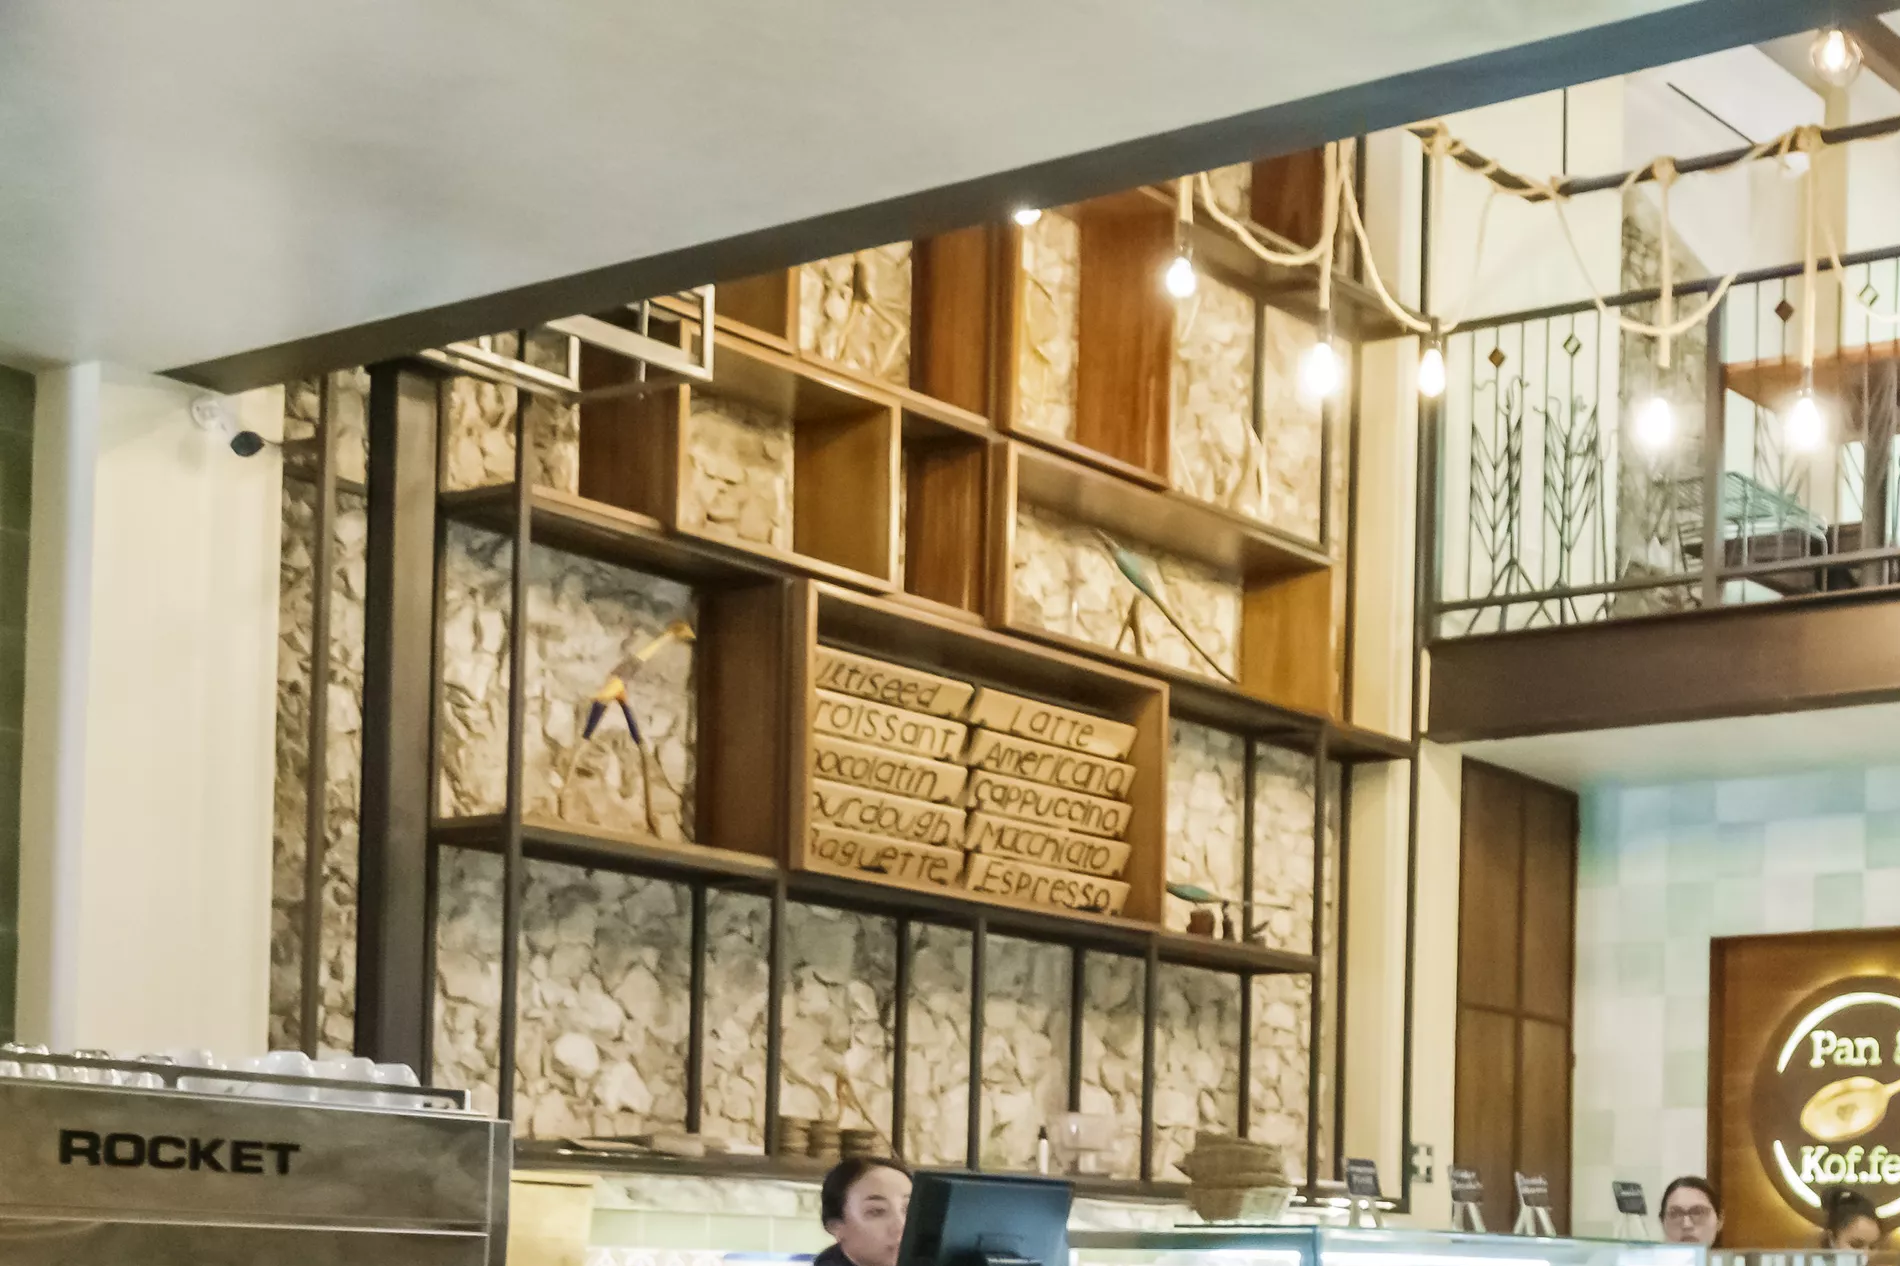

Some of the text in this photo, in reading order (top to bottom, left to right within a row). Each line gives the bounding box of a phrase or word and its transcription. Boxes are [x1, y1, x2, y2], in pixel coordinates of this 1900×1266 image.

[814, 699, 957, 754] roissant
[1010, 705, 1094, 747] Latte
[985, 742, 1125, 794] Americano
[1809, 1030, 1882, 1068] Pan
[58, 1129, 300, 1175] ROCKET
